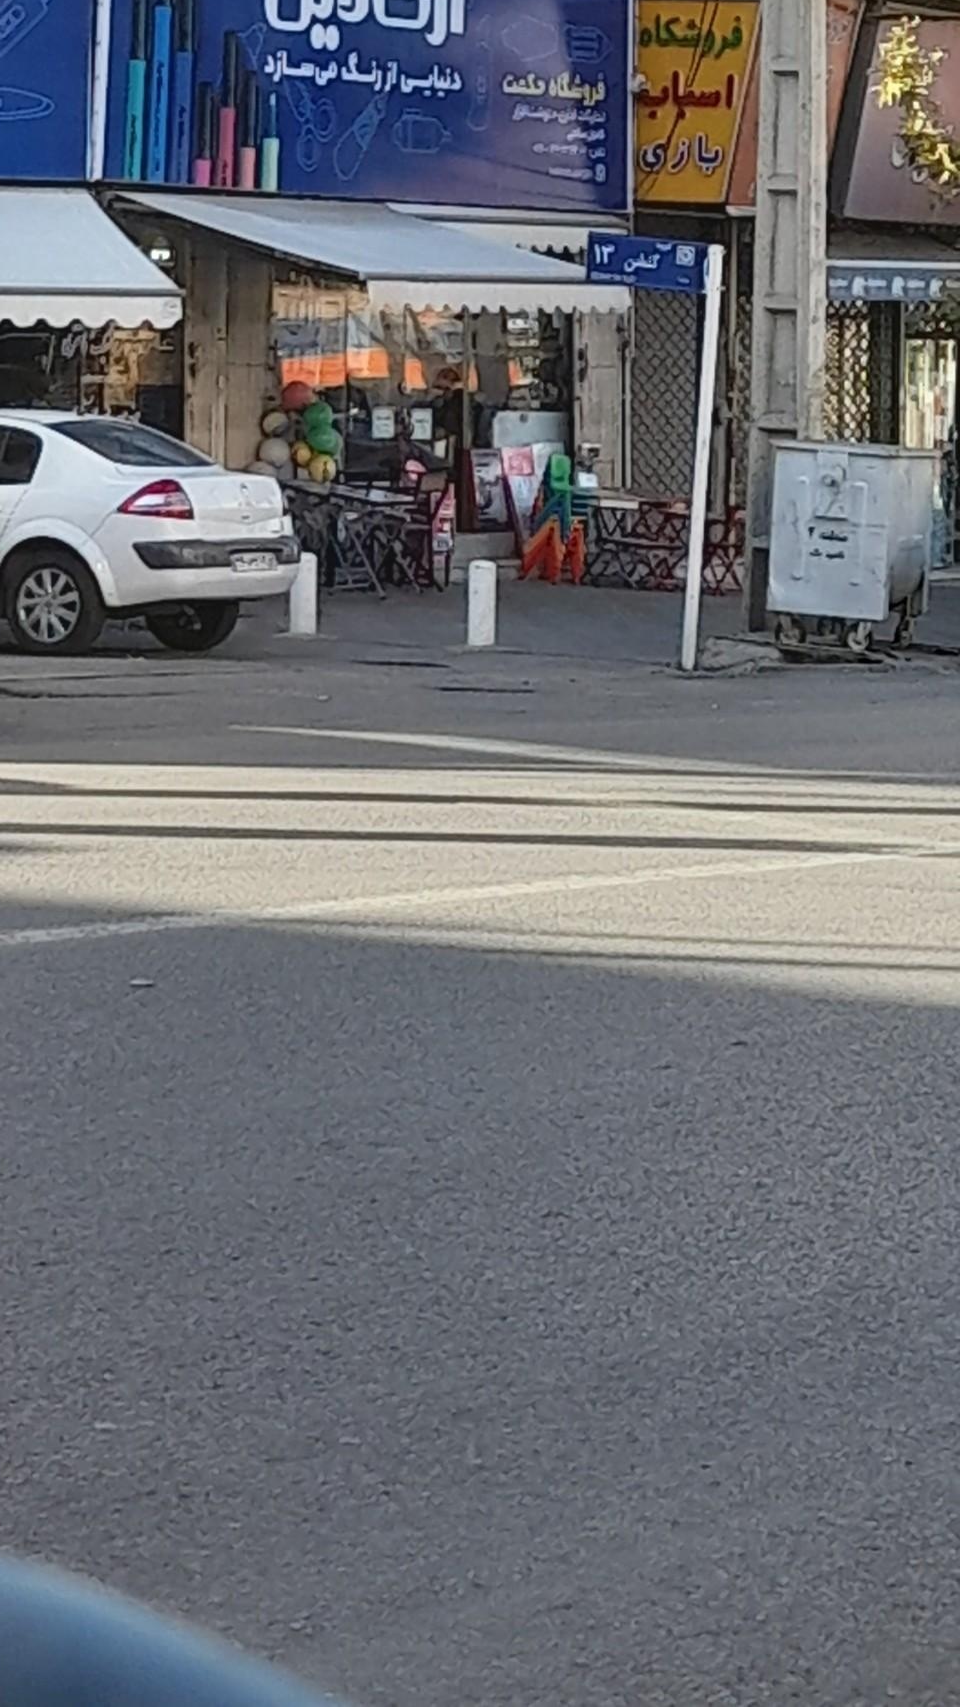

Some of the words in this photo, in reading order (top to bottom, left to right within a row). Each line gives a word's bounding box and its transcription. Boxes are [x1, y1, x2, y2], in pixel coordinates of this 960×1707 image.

[341, 50, 383, 92] رنگ
[384, 60, 399, 93] از
[400, 64, 462, 97] دنیایی
[502, 72, 546, 95] حکمت
[548, 71, 606, 107] فروشگاه
[640, 69, 735, 120] اسباب
[640, 132, 724, 176] بازی
